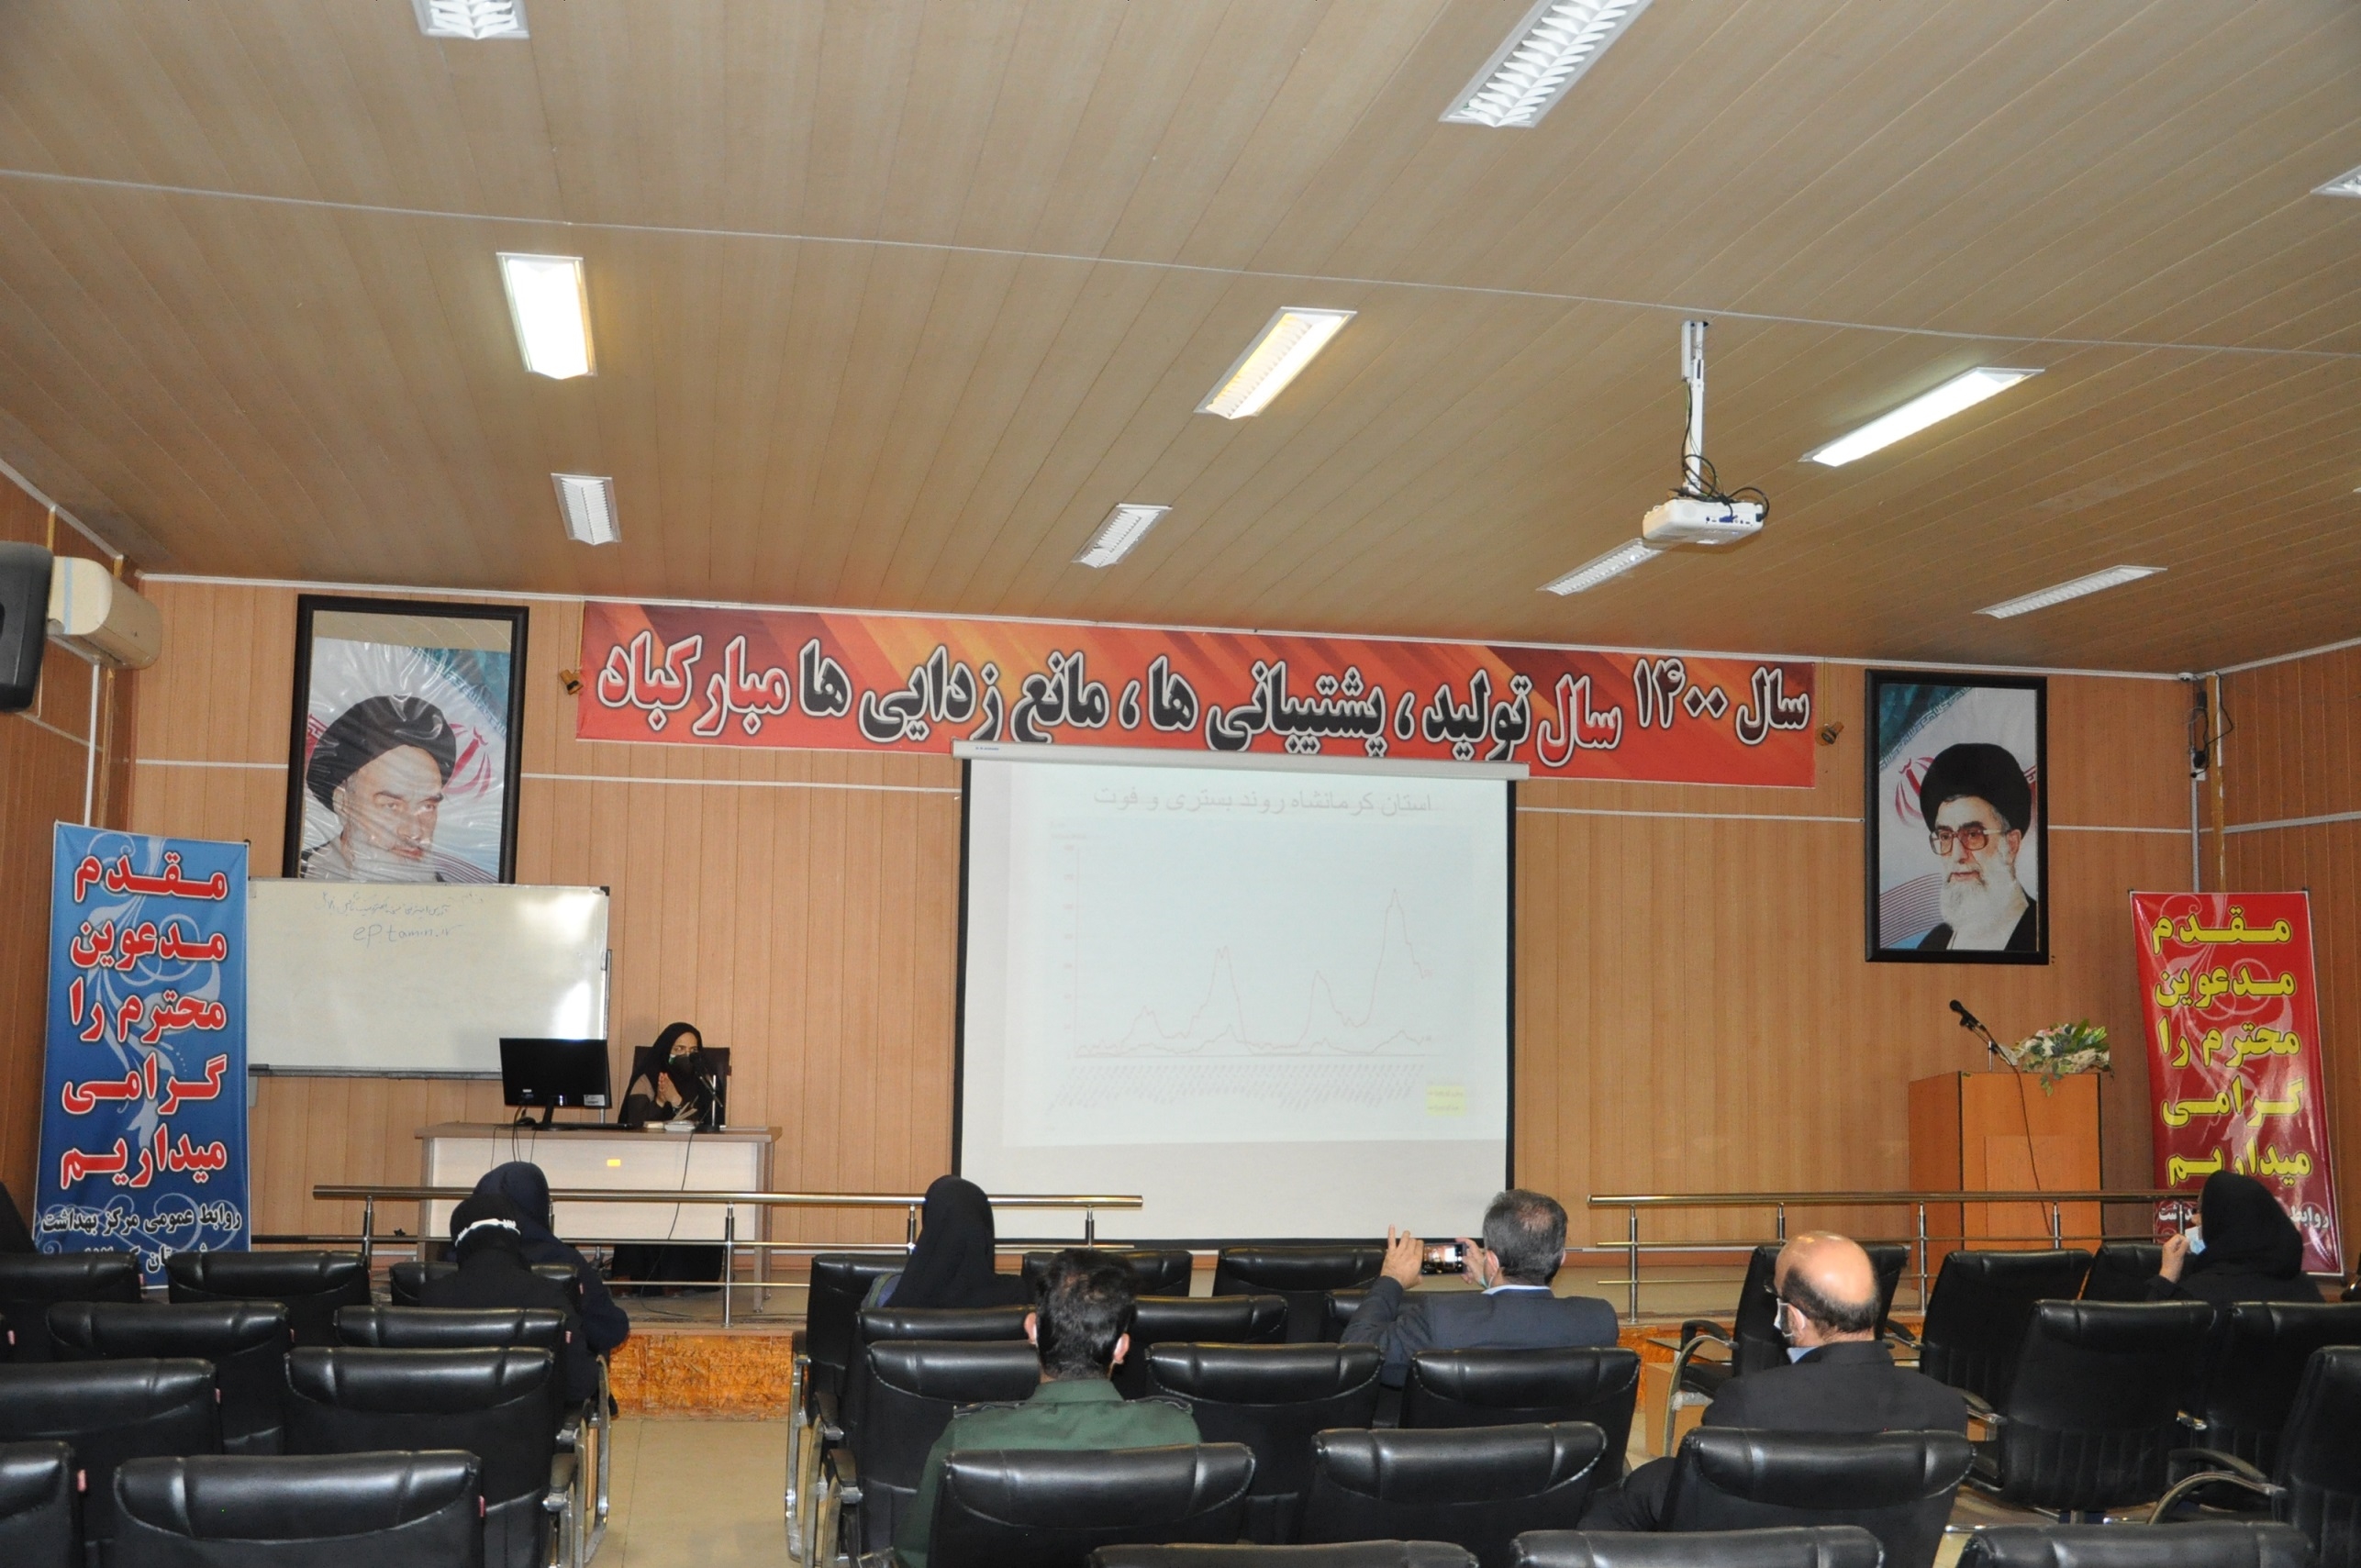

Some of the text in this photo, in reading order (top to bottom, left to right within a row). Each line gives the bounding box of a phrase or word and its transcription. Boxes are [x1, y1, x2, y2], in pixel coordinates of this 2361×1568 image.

[798, 639, 852, 717] ها
[859, 645, 1005, 741] زدایی
[1008, 649, 1110, 742] مانع
[1632, 657, 1730, 730] ۱۴۰۰
[1206, 658, 1387, 758] پشتیبانی
[1537, 672, 1623, 767] سال
[1736, 667, 1811, 747] سال
[1093, 786, 1140, 810] فوت
[1145, 795, 1160, 813] و
[1165, 790, 1233, 814] بستری
[1239, 792, 1289, 815] روند
[1380, 793, 1433, 817] استان
[73, 851, 228, 903] مقدم
[70, 918, 228, 972] مدعوین
[2150, 906, 2292, 955] مقدم
[69, 976, 228, 1043] محترم را
[2155, 965, 2297, 1008] مدعوین
[2157, 1016, 2301, 1068] محترم را
[61, 1051, 228, 1115] گرامی
[2161, 1075, 2305, 1129] گرامی
[59, 1121, 228, 1190] میداریم
[41, 1202, 242, 1237] روابط عمومی مرکز بهداشت
